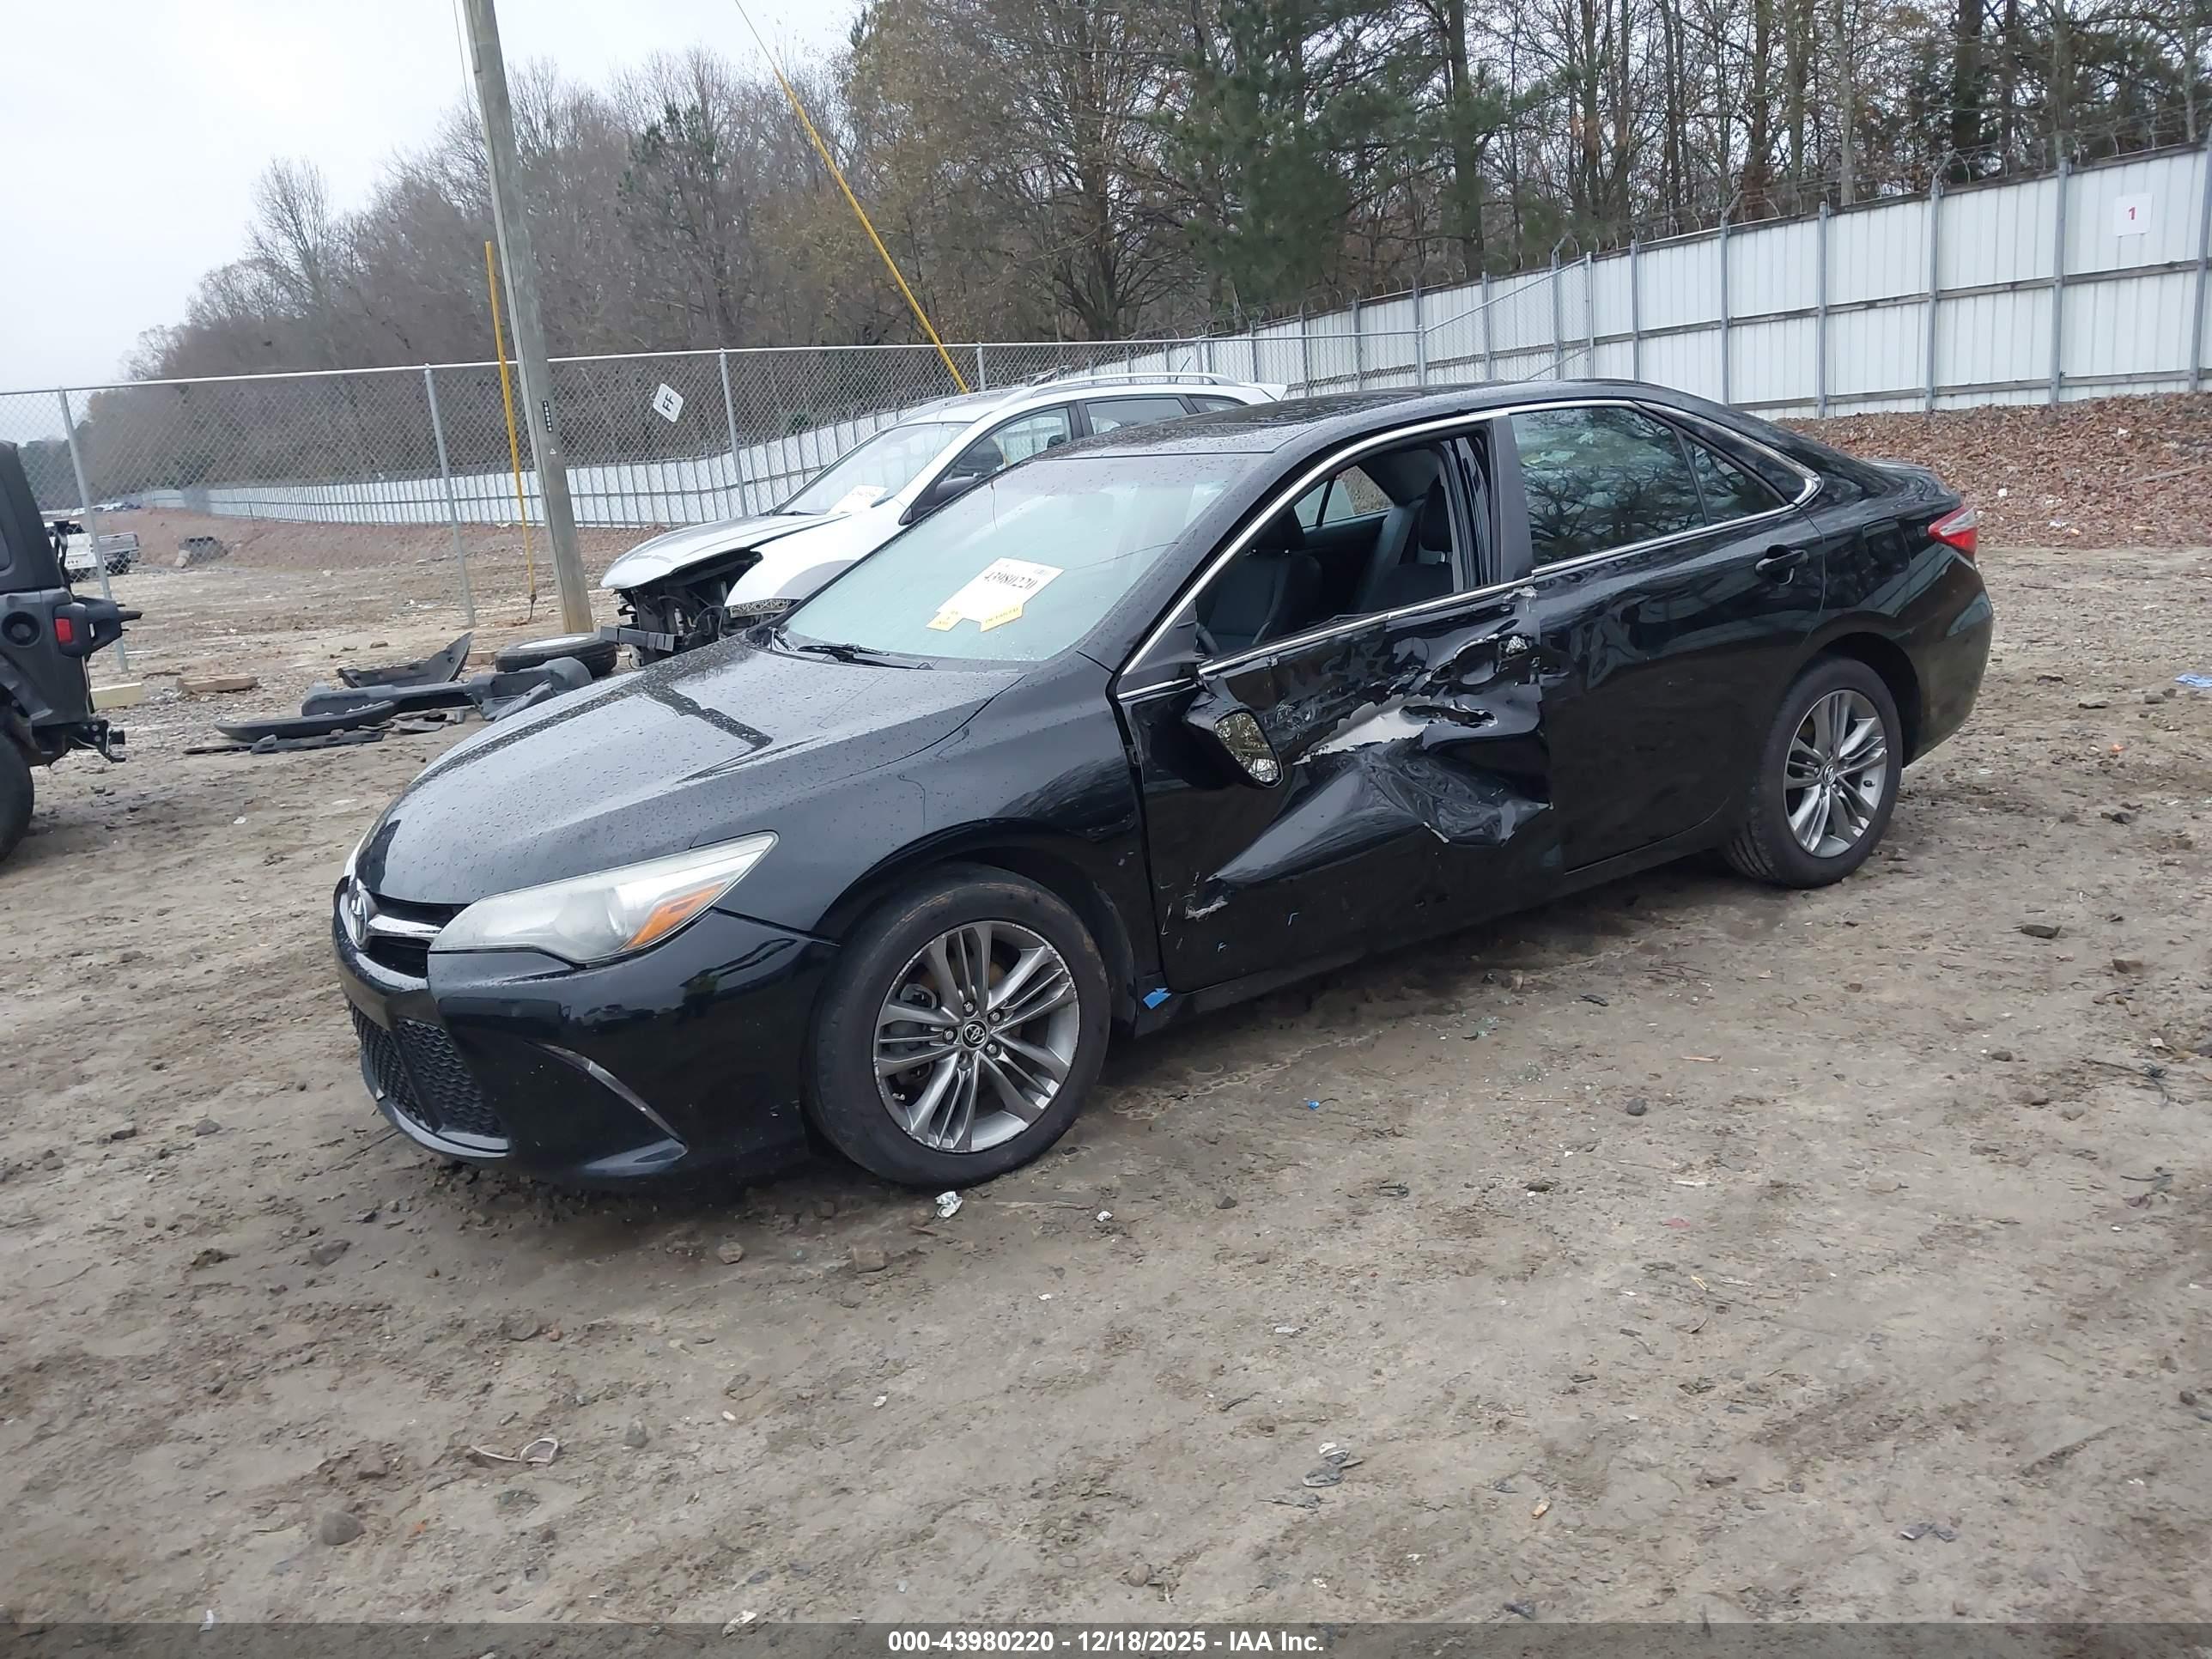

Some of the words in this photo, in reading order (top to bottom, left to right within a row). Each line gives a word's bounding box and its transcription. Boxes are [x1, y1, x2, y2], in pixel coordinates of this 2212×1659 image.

[2129, 206, 2136, 221] 1
[661, 393, 674, 412] FF
[984, 571, 1037, 590] 43980220
